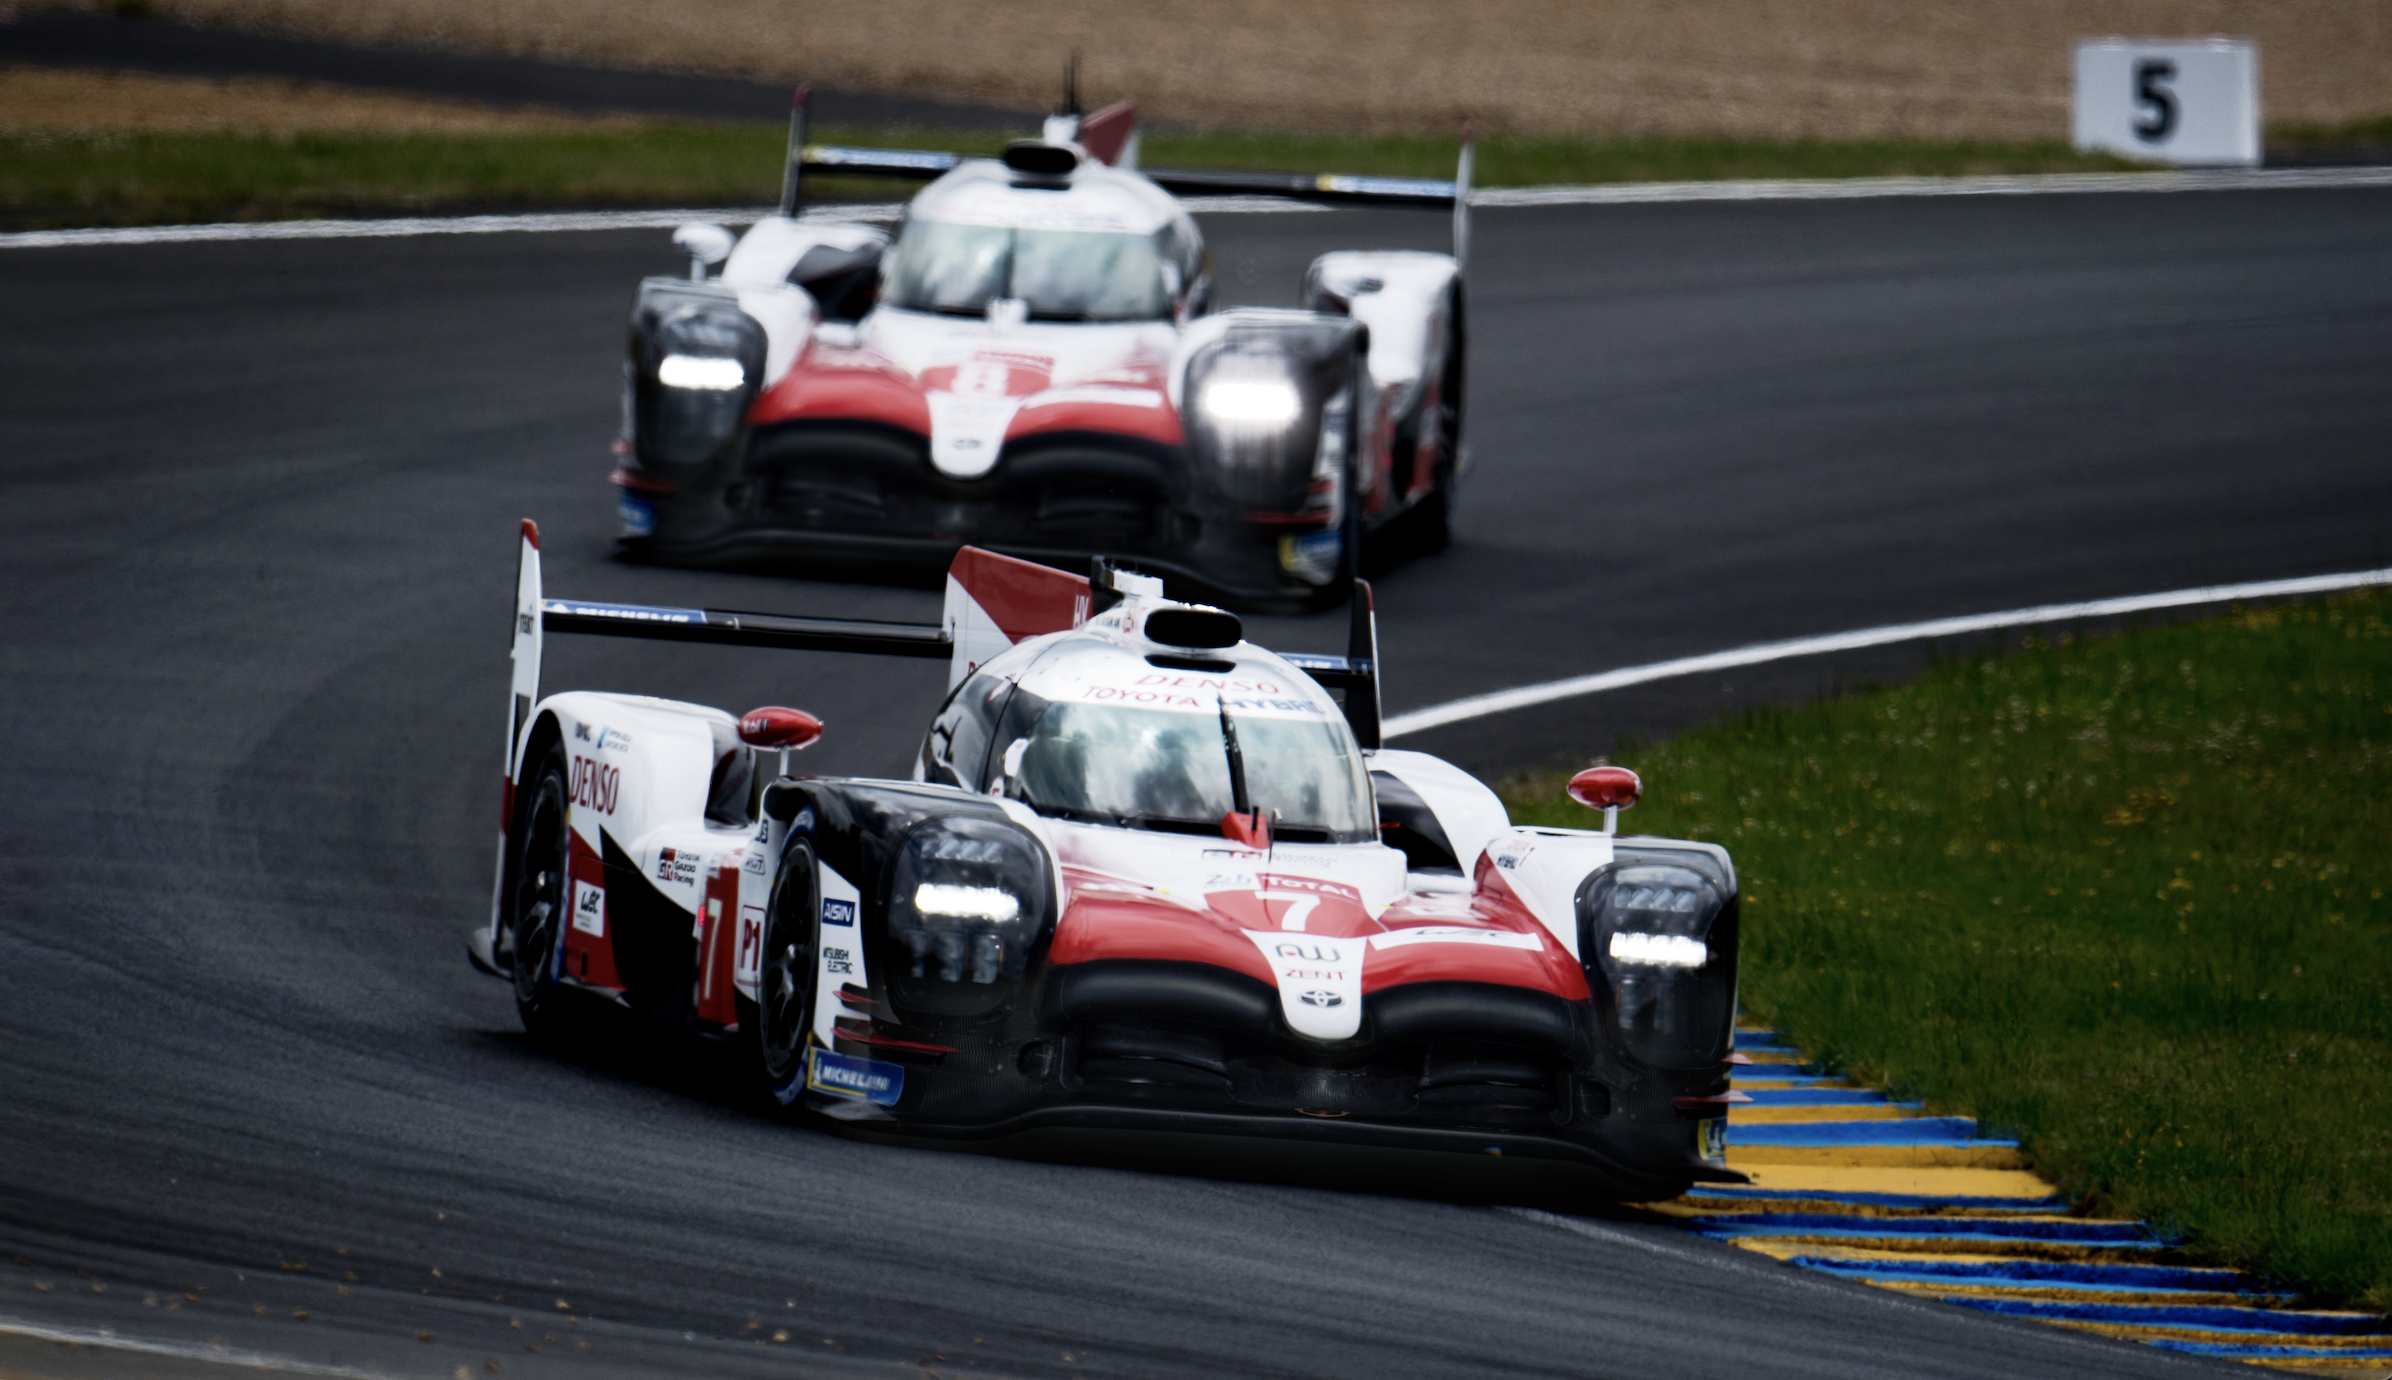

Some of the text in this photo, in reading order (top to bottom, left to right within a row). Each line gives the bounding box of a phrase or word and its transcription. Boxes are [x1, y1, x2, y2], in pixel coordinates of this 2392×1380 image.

[2130, 56, 2181, 145] 5
[1083, 686, 1200, 707] TOYOTA
[1136, 674, 1280, 694] DENSO
[569, 754, 620, 816] DENSO
[1262, 876, 1358, 899] TOTAL
[823, 903, 853, 922] AISIN
[1254, 890, 1321, 931] 7
[704, 898, 723, 999] 7
[740, 918, 761, 971] P1
[1284, 966, 1347, 980] ZENT
